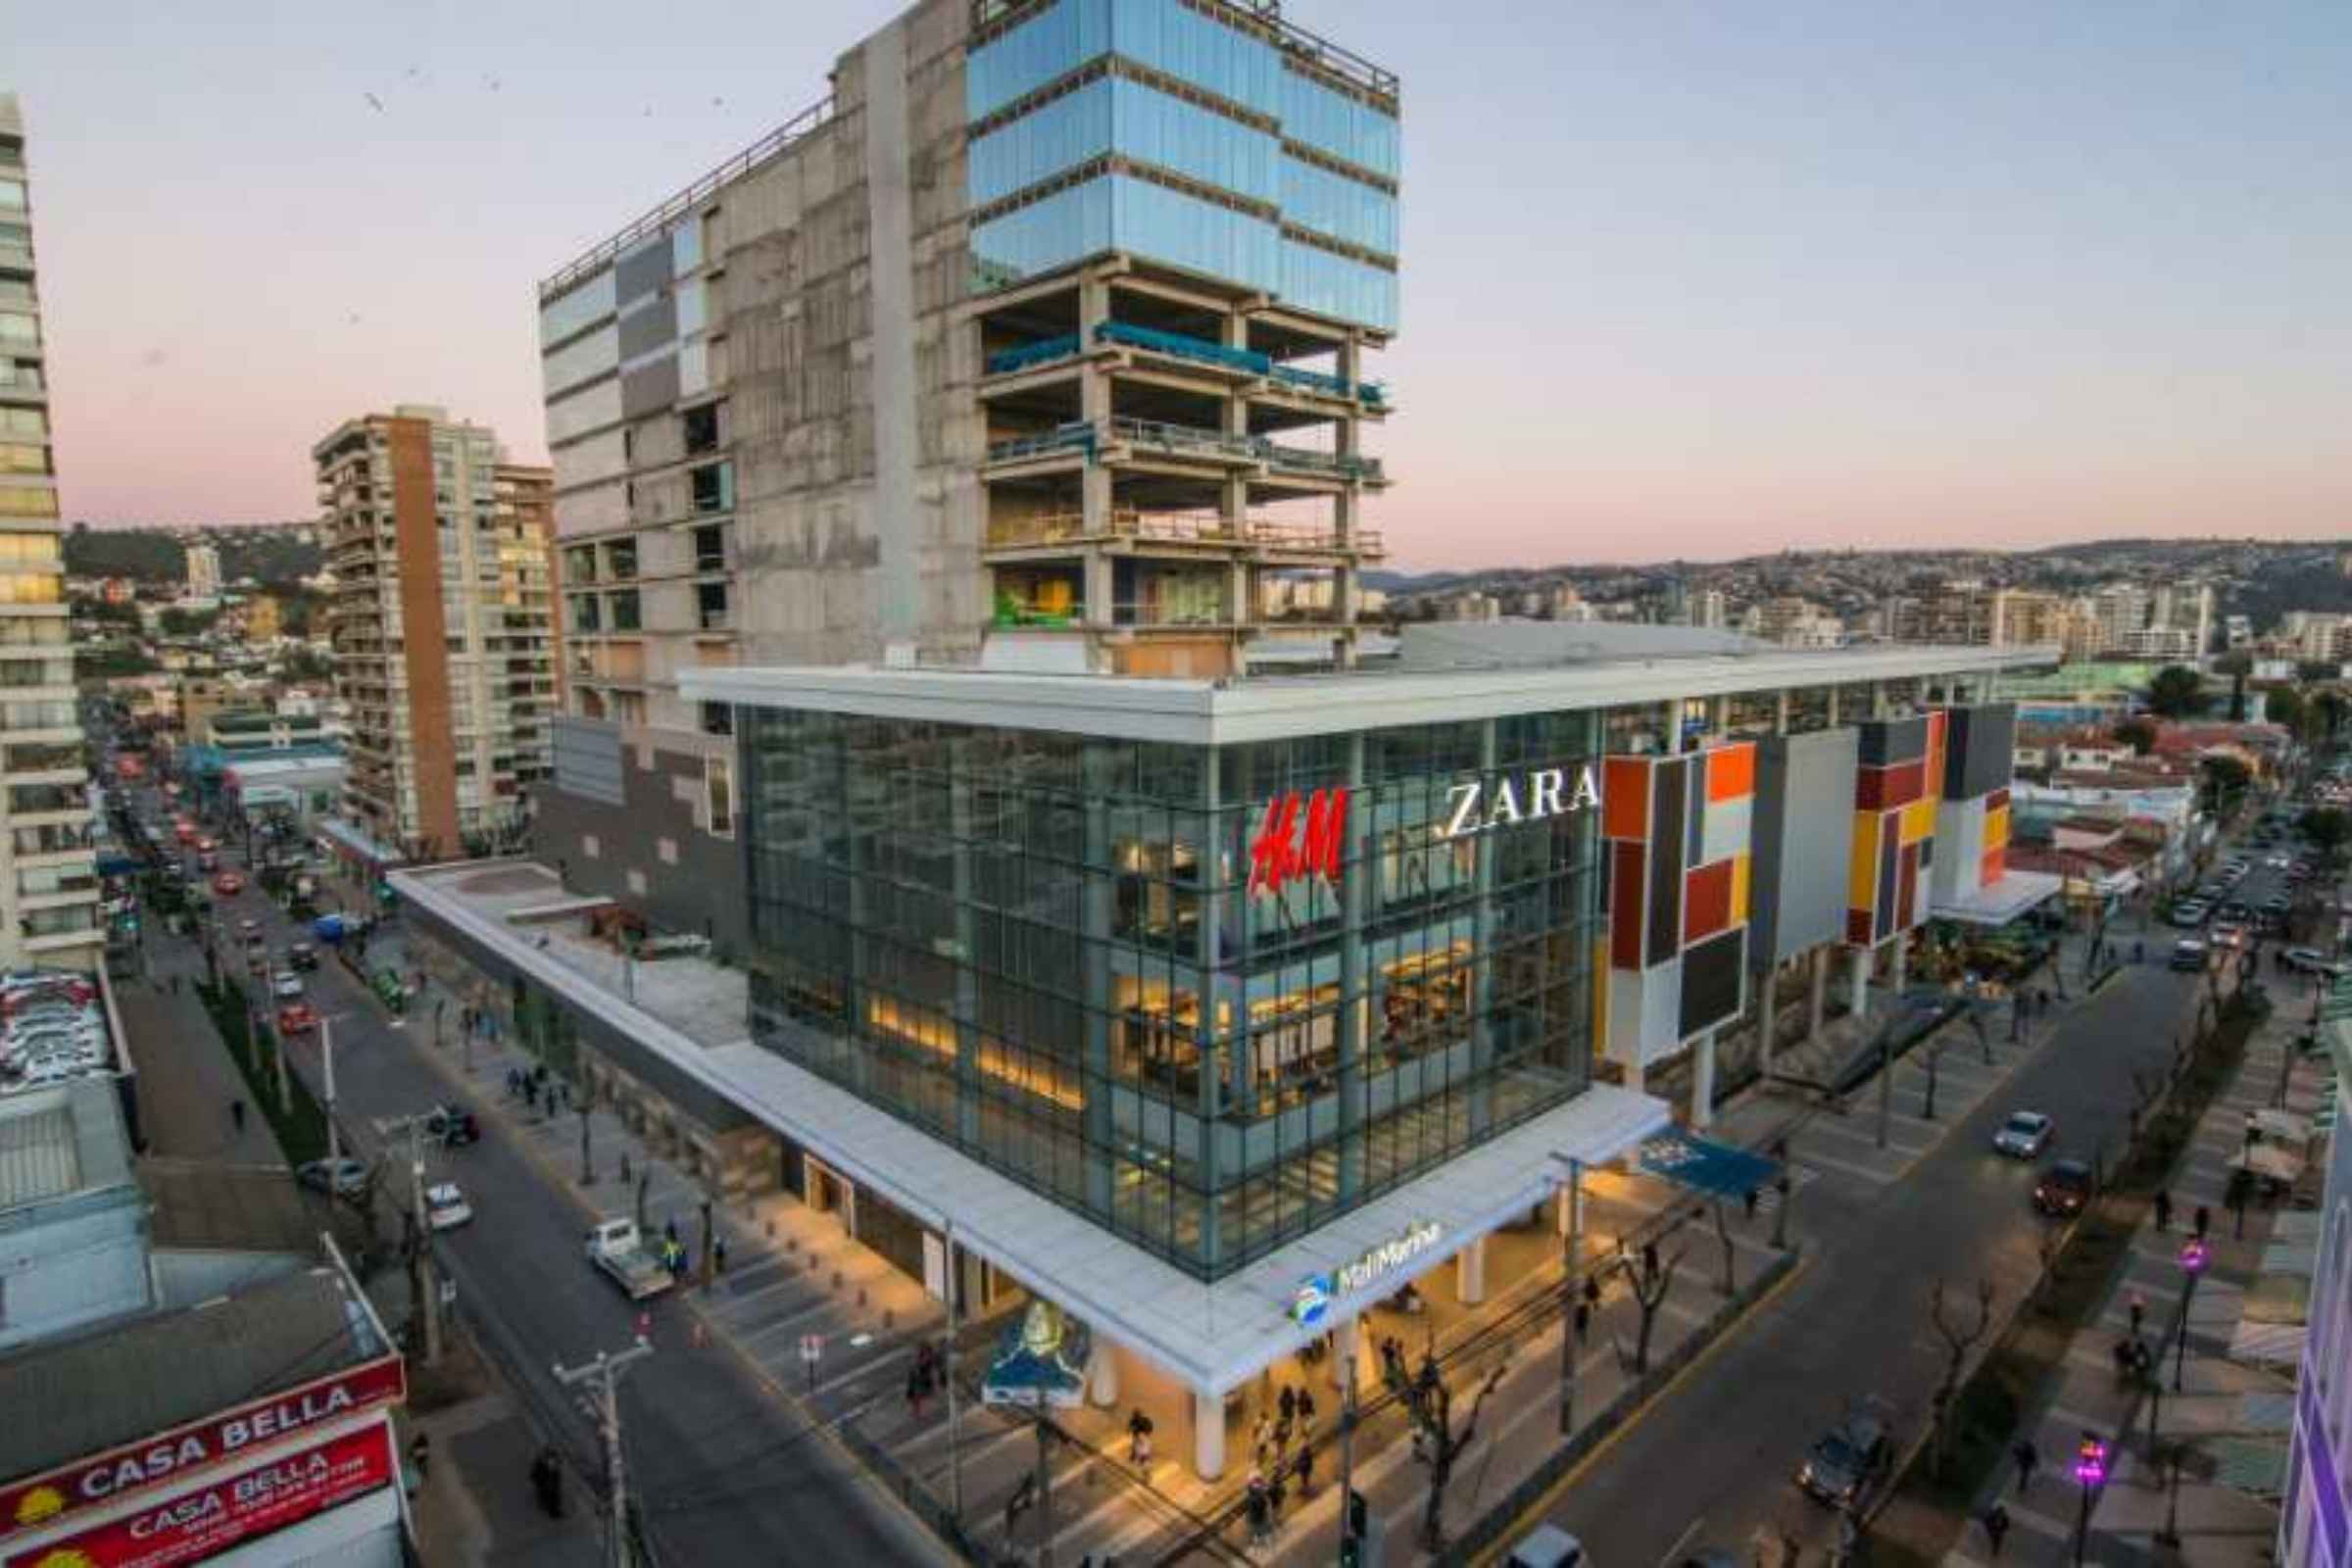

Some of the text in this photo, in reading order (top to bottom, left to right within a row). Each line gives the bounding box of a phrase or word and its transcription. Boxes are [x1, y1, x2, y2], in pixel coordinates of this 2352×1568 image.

[1250, 788, 1348, 896] H&M
[1446, 765, 1599, 837] ZARA
[81, 1388, 354, 1496] CASA BELLA
[129, 1494, 222, 1539] CASA
[235, 1453, 328, 1500] BELLA
